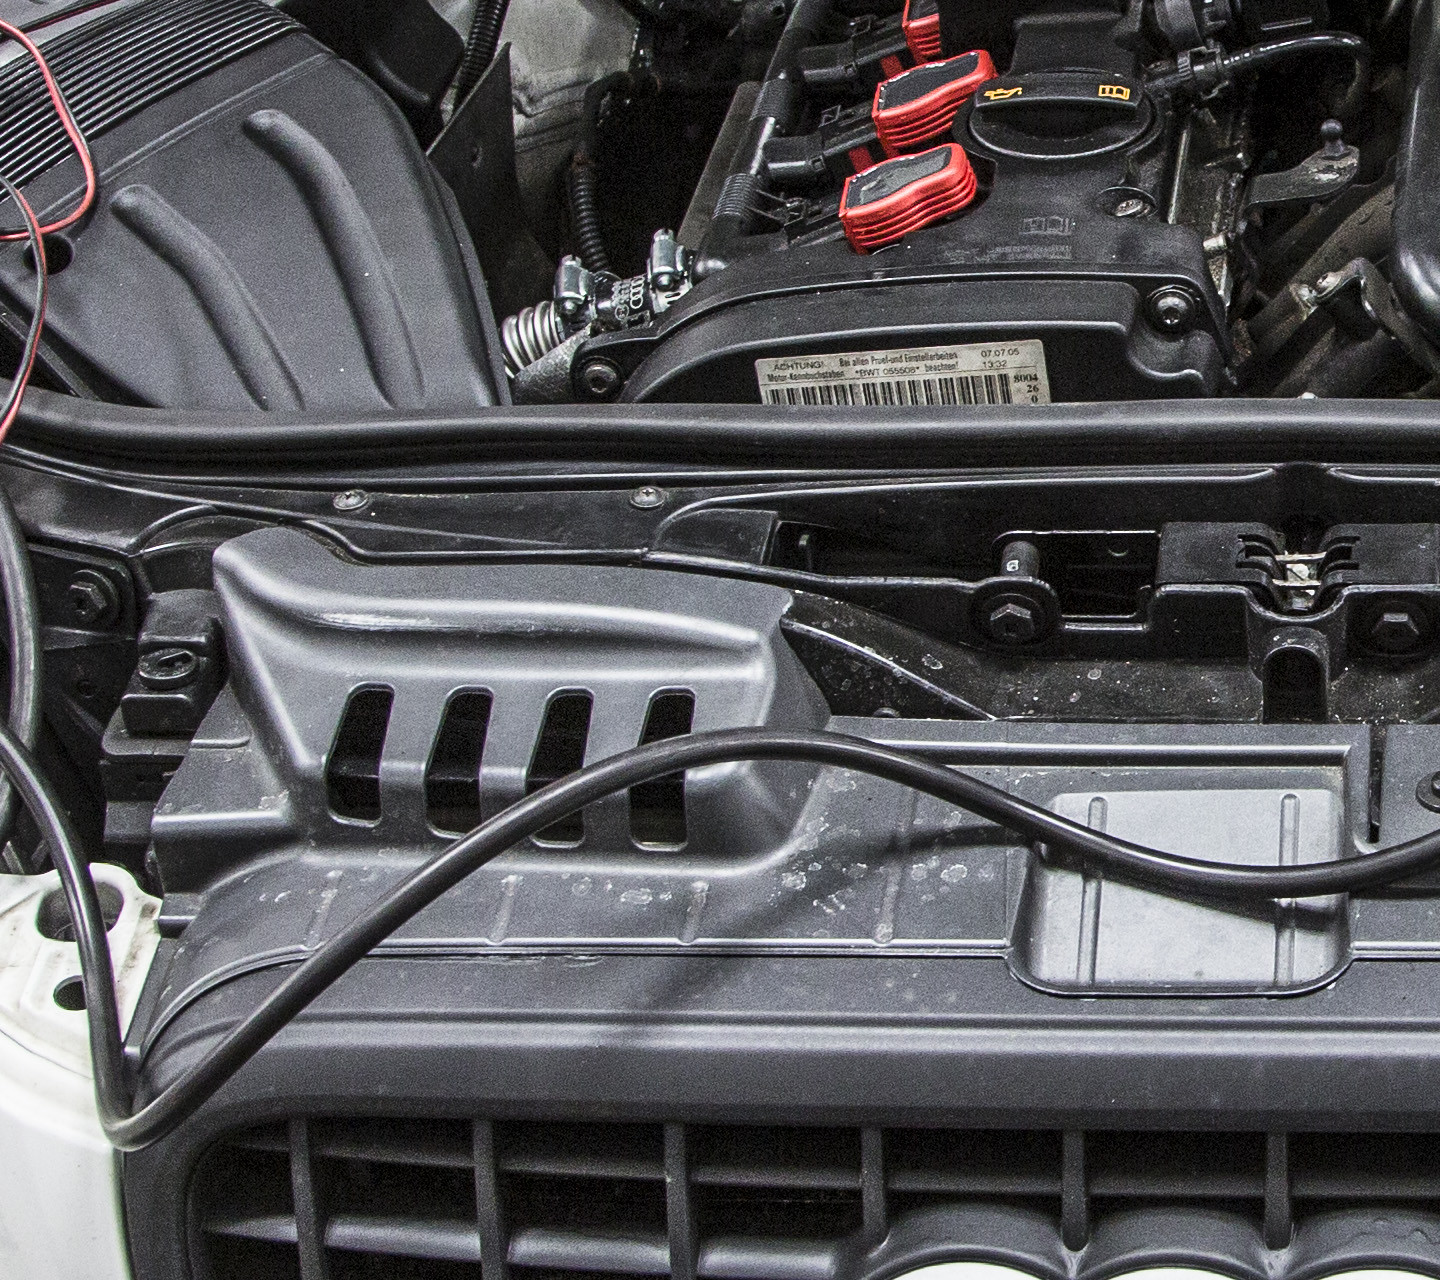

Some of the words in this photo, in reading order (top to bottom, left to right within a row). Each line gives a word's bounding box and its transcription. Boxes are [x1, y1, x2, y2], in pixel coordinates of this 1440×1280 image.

[774, 360, 824, 371] ACHTUNG!
[1013, 373, 1039, 383] 8004
[1027, 384, 1039, 393] 26
